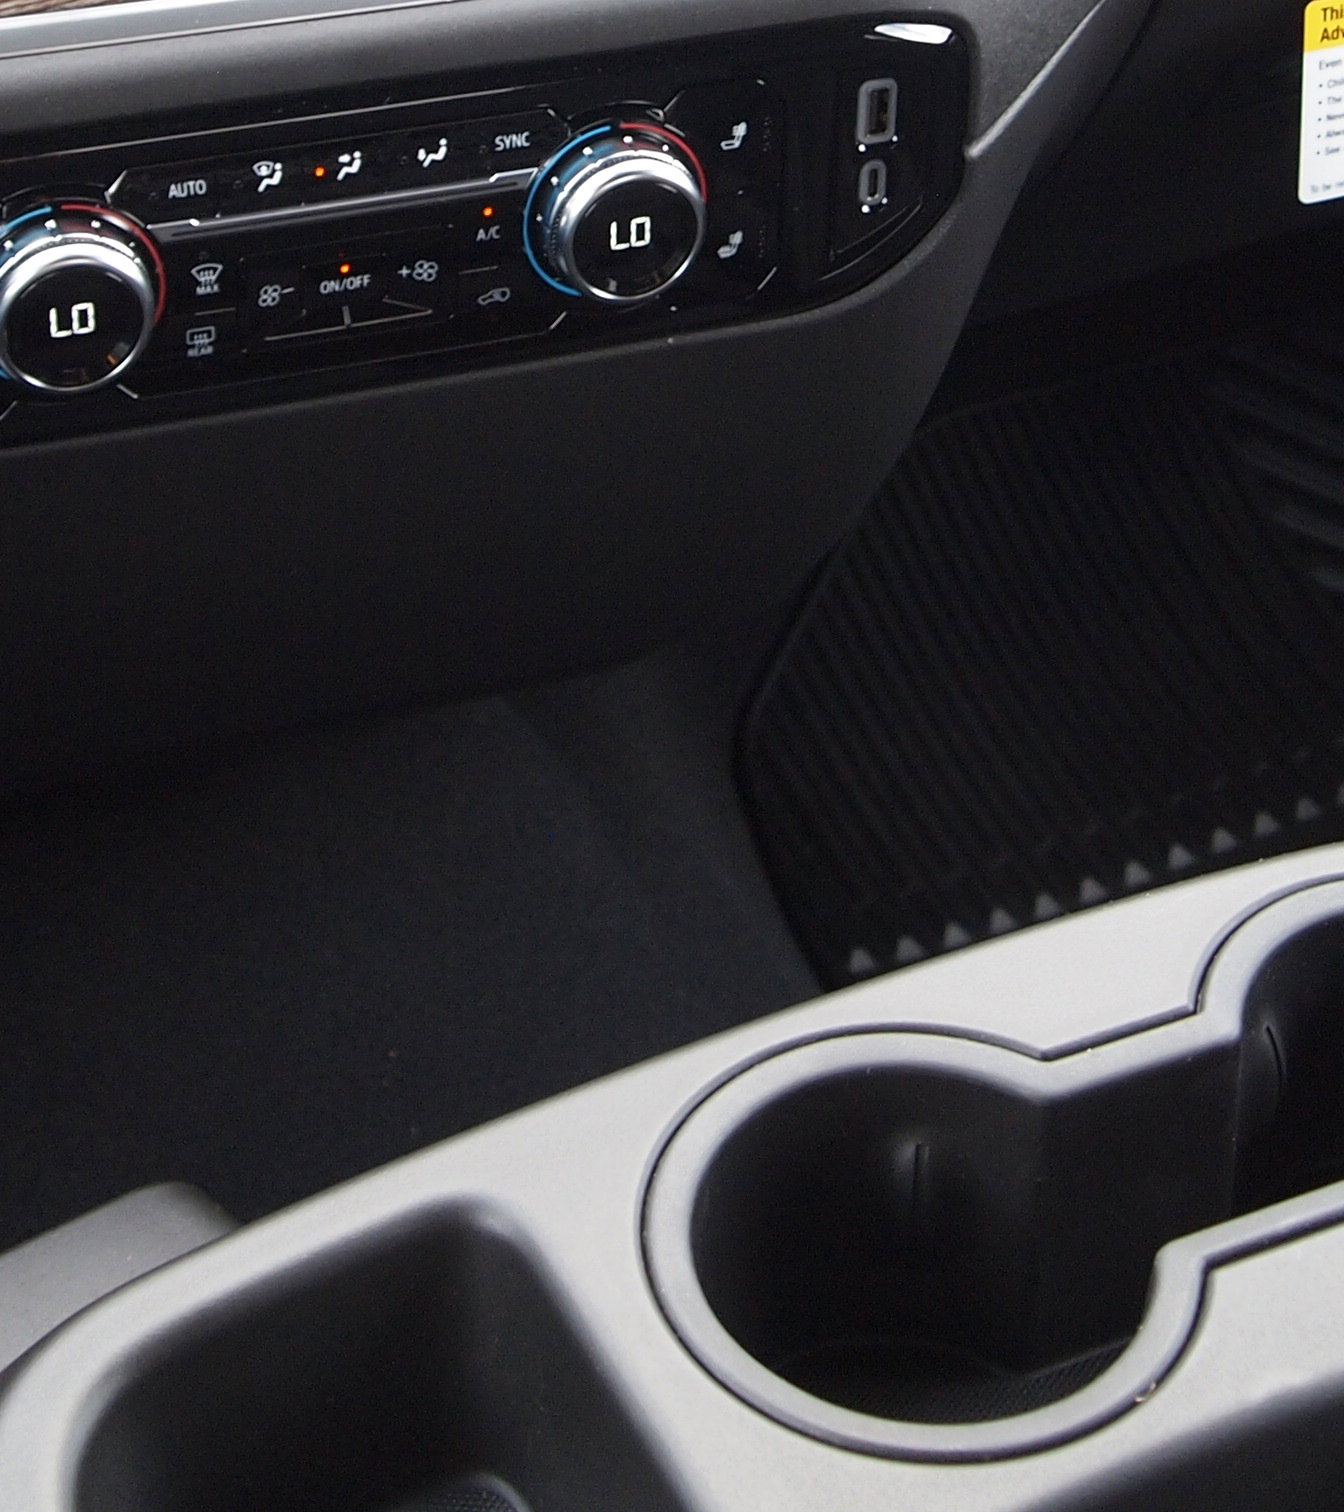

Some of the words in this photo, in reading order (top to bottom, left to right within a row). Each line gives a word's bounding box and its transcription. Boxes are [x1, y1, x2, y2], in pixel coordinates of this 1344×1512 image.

[493, 131, 531, 151] SYNC
[168, 179, 207, 199] AUTO
[476, 225, 501, 242] A/C
[609, 215, 652, 251] LO
[196, 283, 220, 295] MAX
[319, 274, 373, 294] ON/OFF
[48, 301, 96, 338] LO
